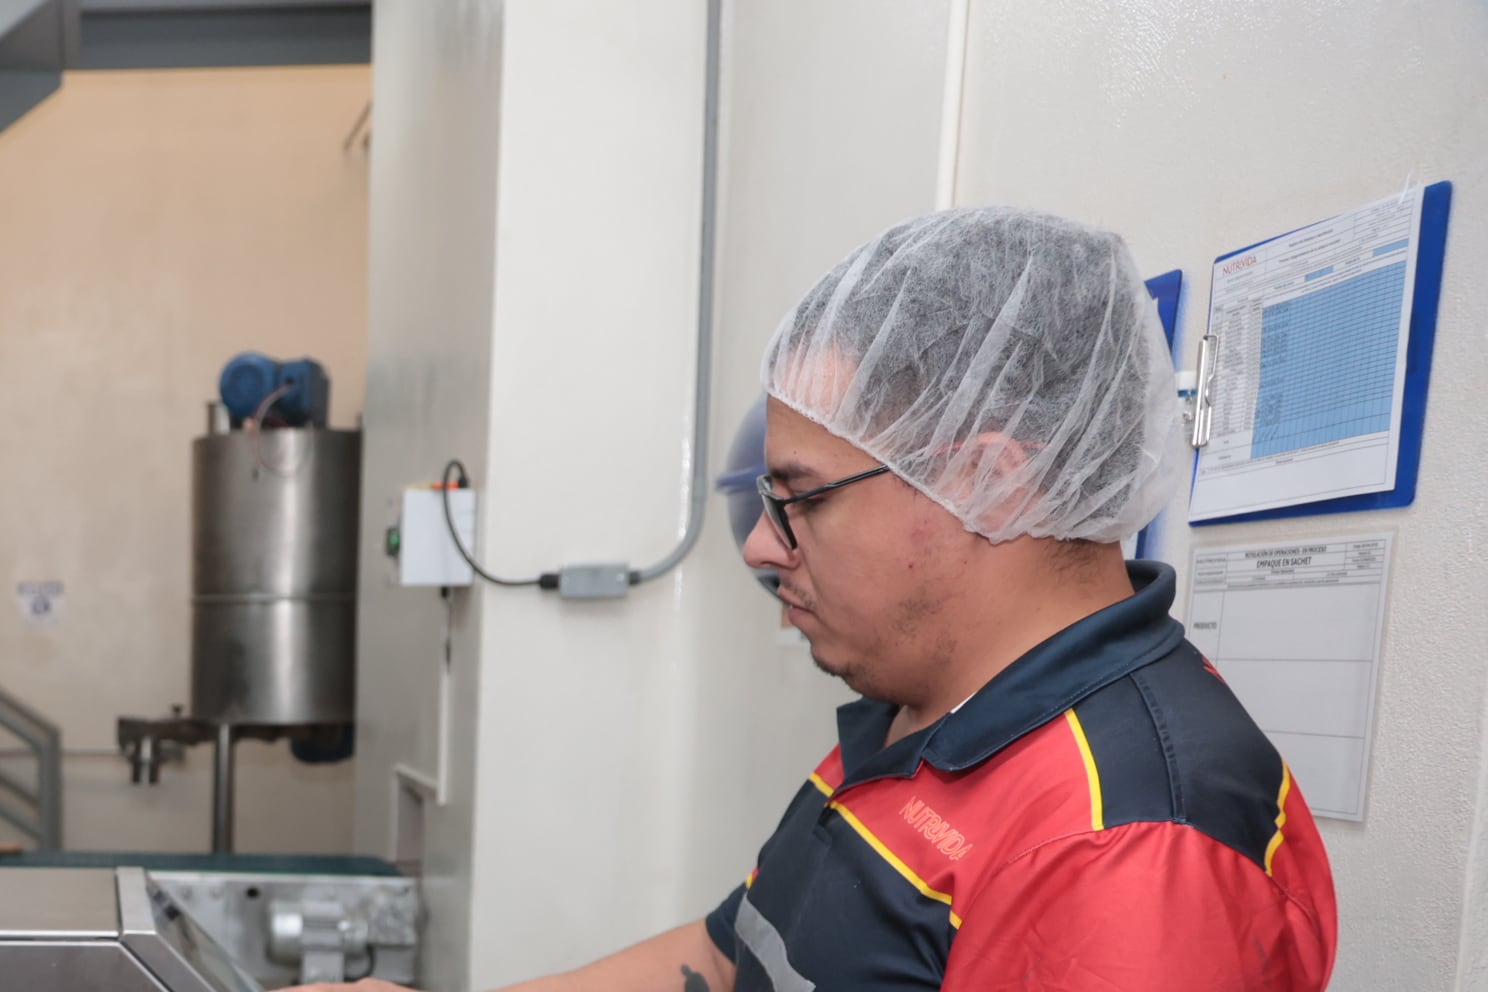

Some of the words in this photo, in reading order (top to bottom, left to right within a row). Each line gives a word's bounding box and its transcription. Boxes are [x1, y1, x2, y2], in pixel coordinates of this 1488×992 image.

[1222, 255, 1257, 275] NUTRIVIDA
[1256, 558, 1282, 569] EMPAQUE
[1282, 557, 1290, 567] EN
[1290, 556, 1312, 566] SACHET
[898, 795, 973, 861] NUTRIVIDA
